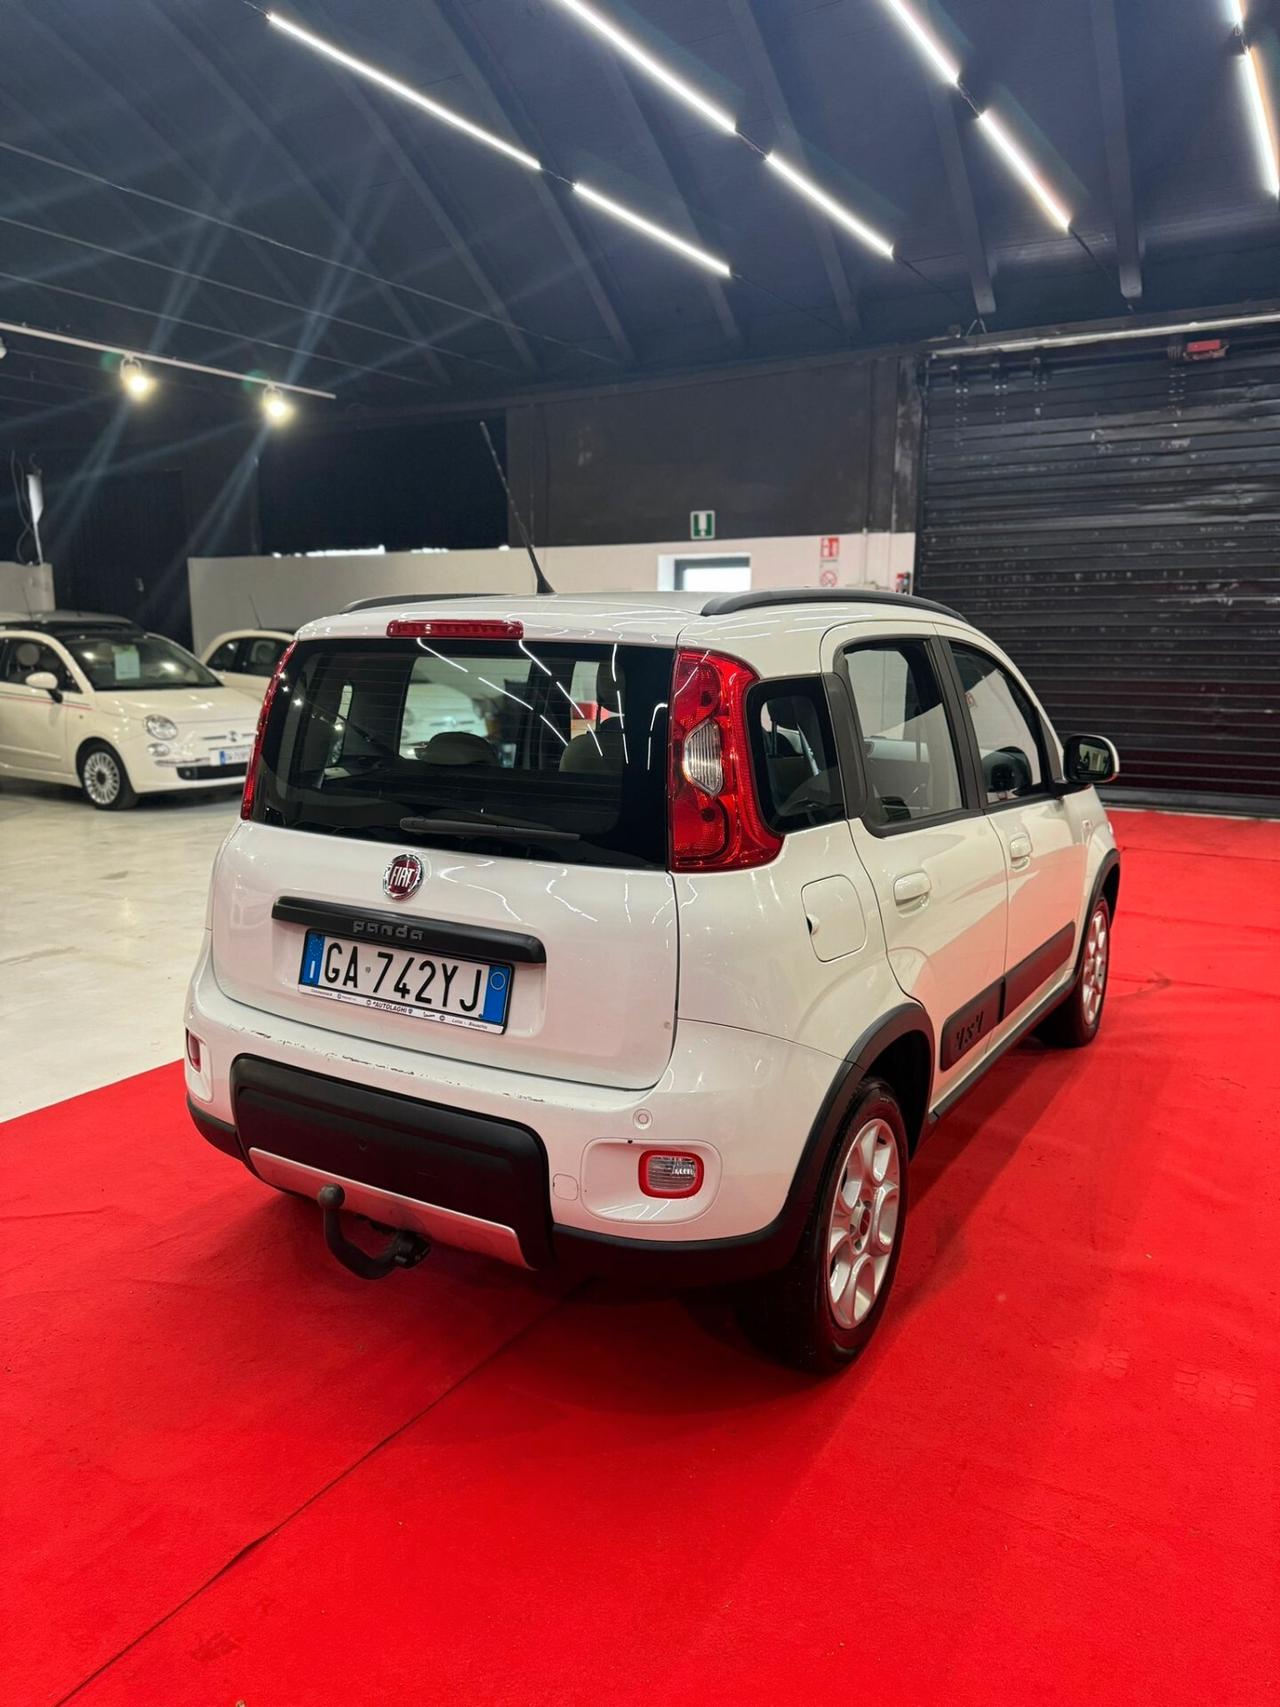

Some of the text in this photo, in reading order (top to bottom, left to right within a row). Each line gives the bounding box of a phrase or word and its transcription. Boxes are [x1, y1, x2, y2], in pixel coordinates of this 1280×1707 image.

[390, 866, 416, 888] FIAT
[352, 920, 424, 941] panda
[323, 942, 483, 1012] GA 742YJ
